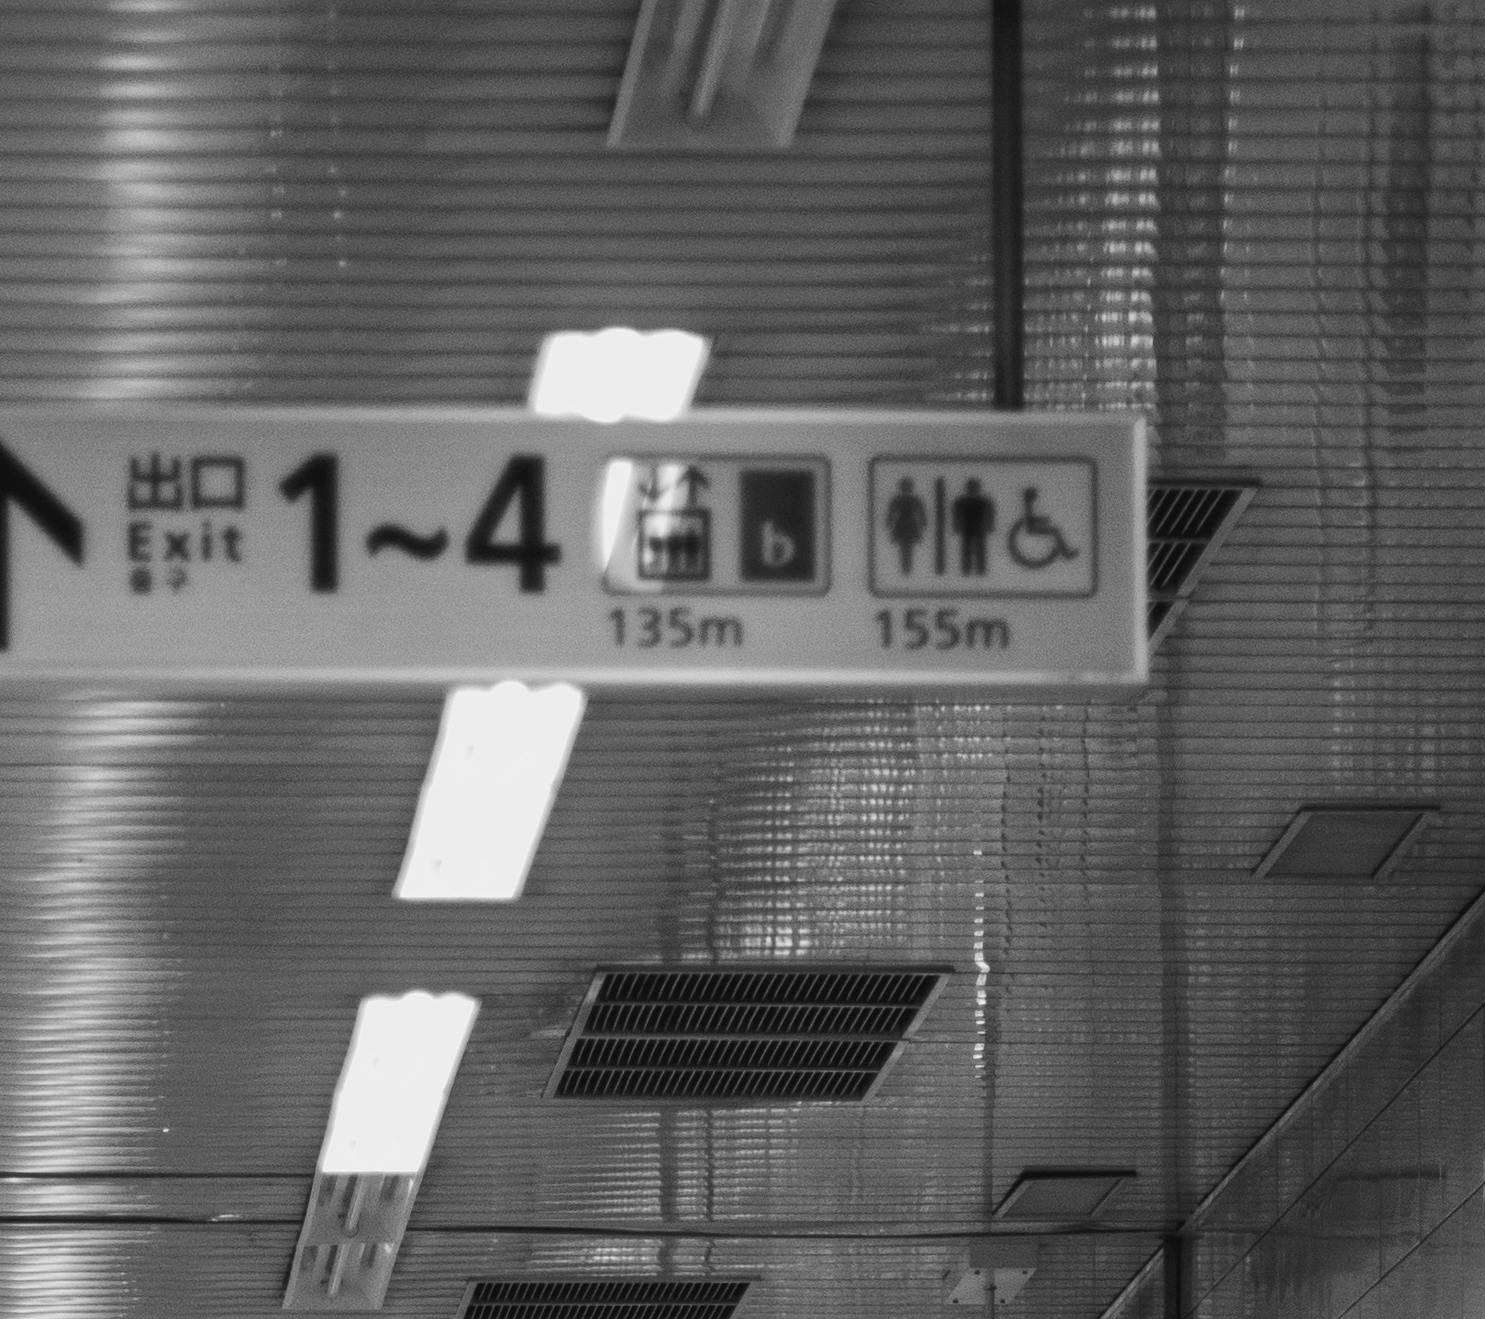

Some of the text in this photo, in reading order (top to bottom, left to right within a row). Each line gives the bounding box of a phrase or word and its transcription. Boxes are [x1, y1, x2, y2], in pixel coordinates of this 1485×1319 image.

[127, 453, 245, 512] 出口
[127, 519, 244, 564] Exit
[606, 607, 743, 648] 135m
[873, 609, 1011, 650] 155m
